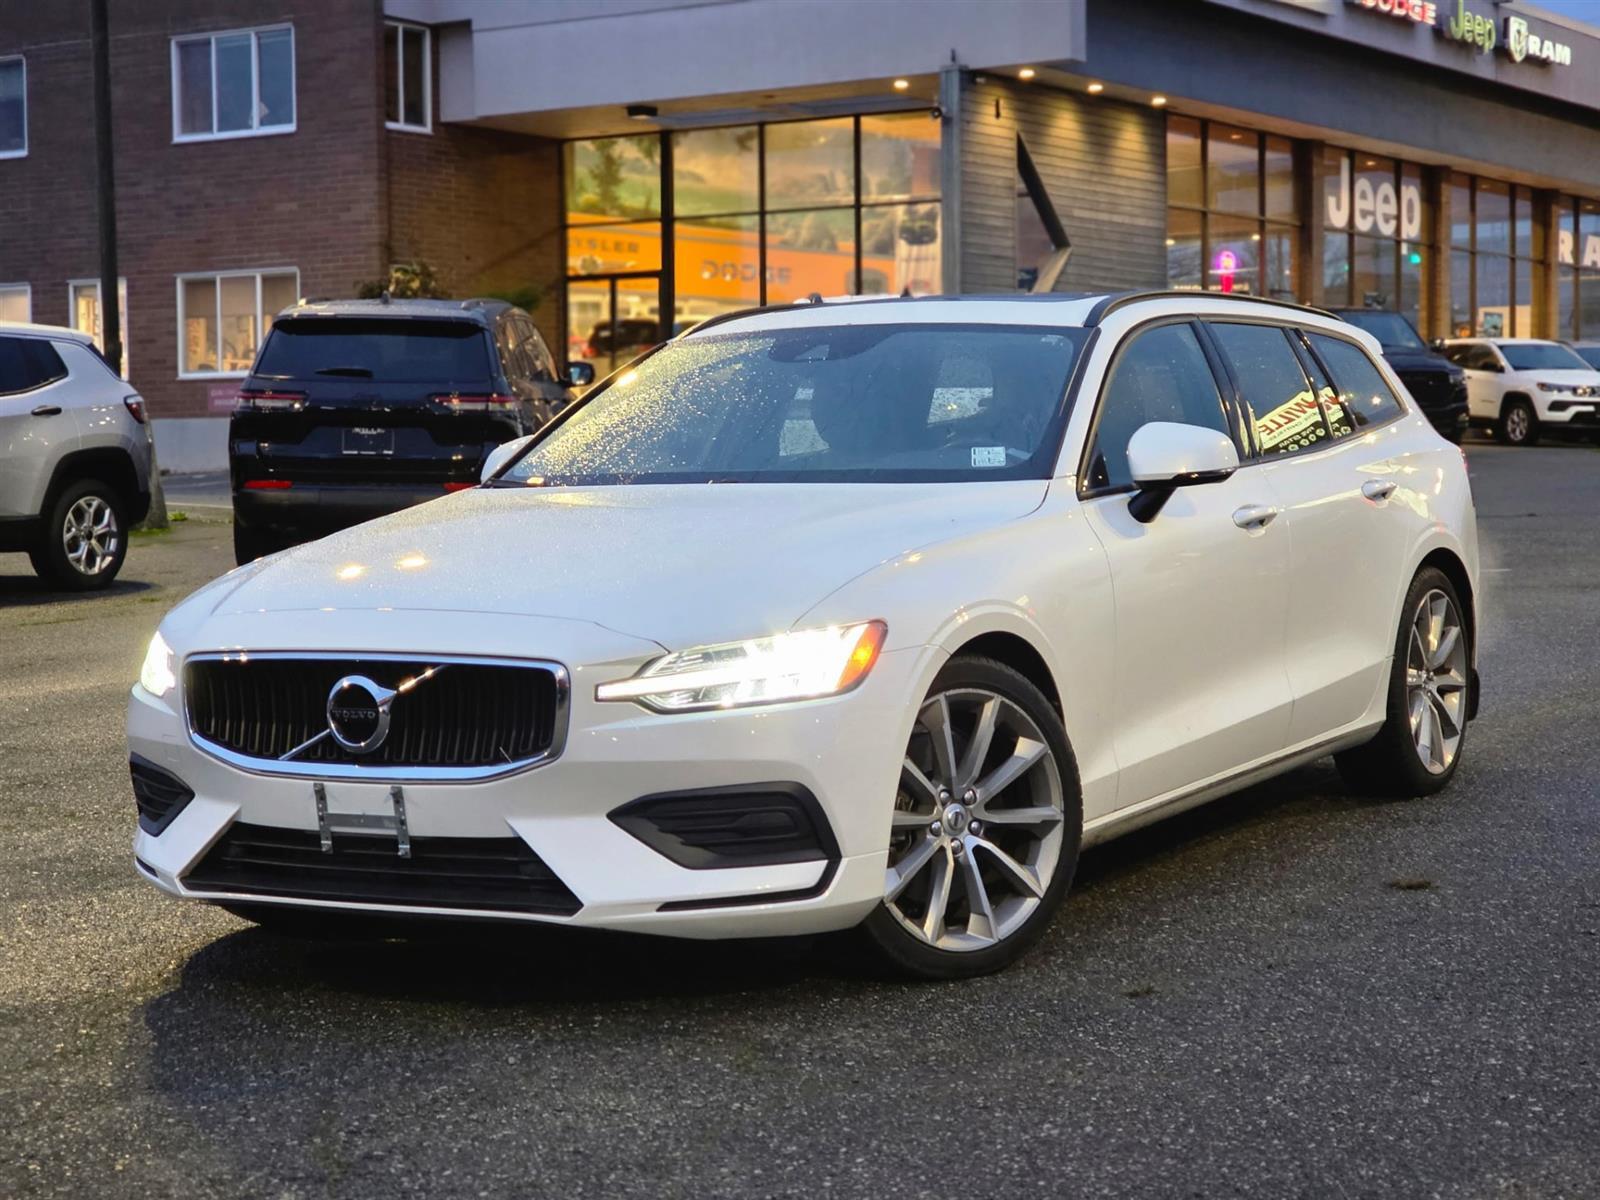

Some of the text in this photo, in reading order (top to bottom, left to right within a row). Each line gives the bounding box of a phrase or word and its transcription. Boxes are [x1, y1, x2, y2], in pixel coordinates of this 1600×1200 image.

[1450, 0, 1496, 54] Jeep
[1528, 34, 1571, 66] RAM
[1327, 157, 1421, 255] Jeep
[331, 709, 377, 719] VOLVO
